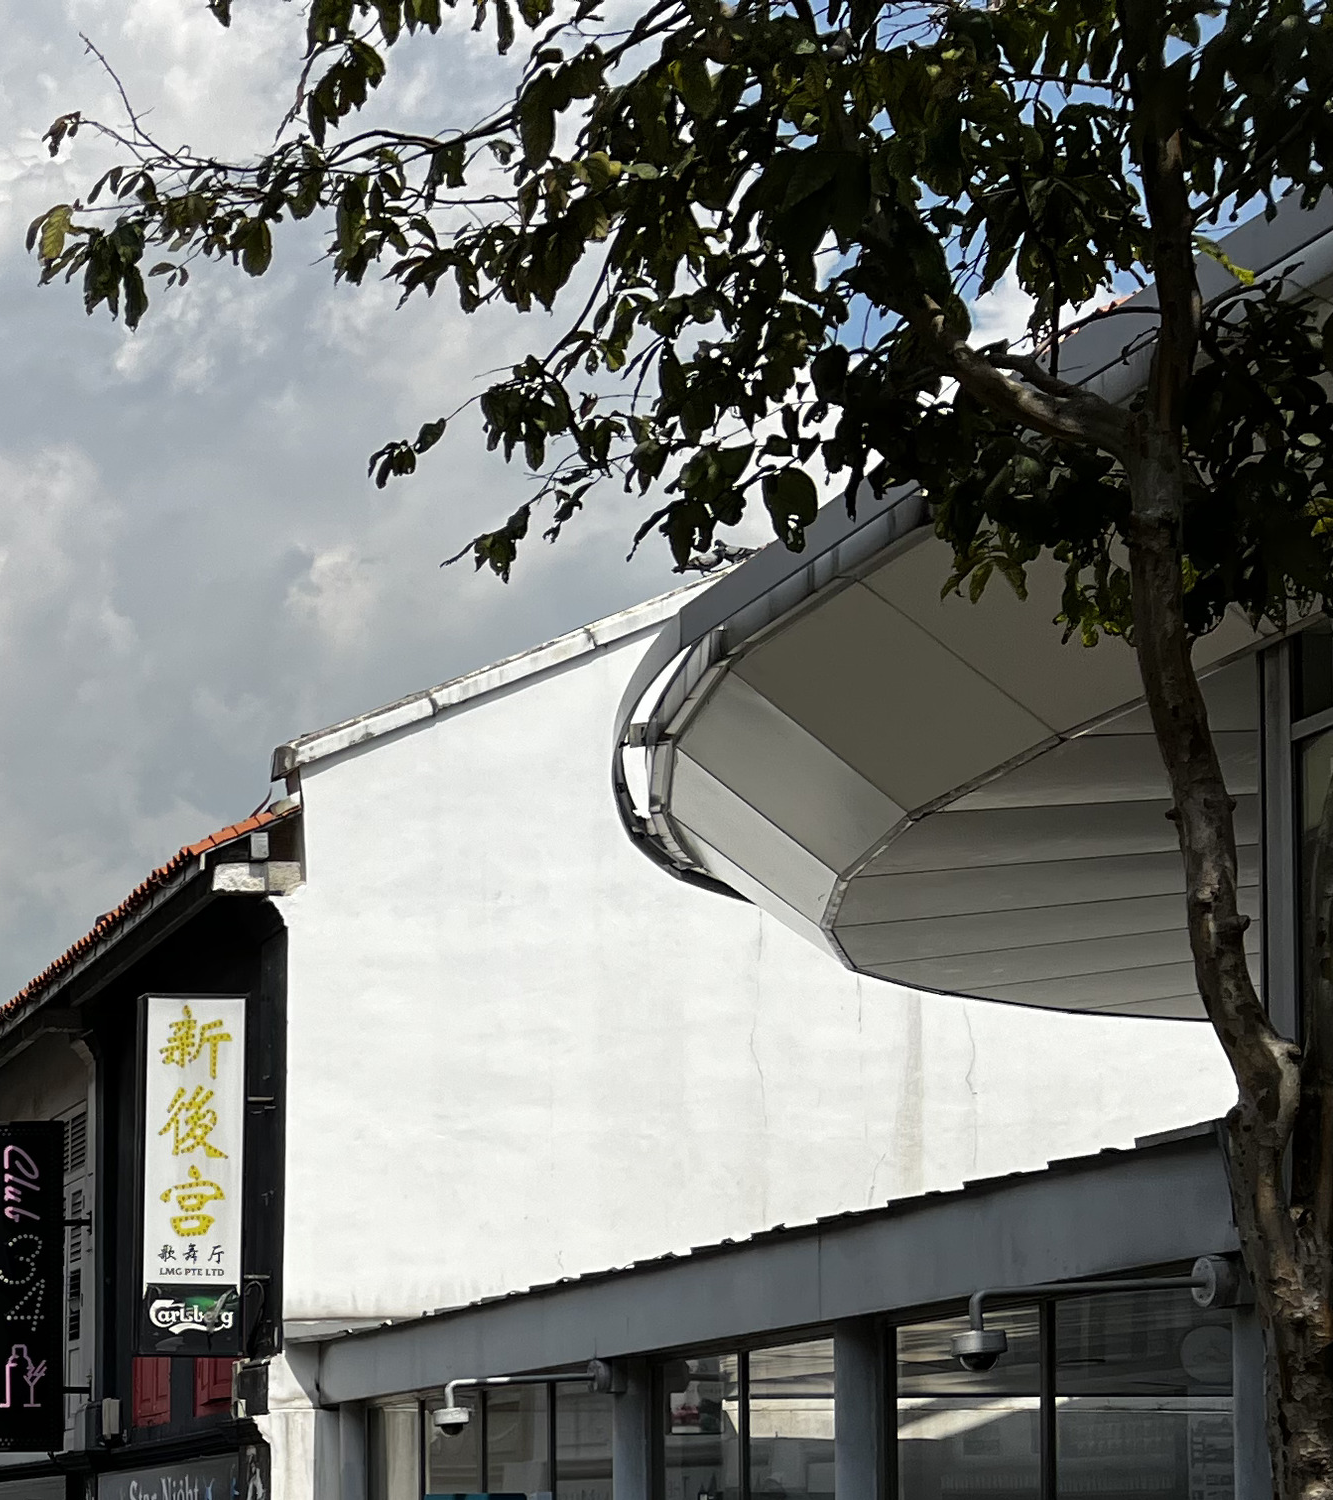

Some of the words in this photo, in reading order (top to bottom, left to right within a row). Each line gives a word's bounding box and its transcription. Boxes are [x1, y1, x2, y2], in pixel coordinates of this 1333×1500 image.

[3, 1145, 41, 1223] Club
[158, 1243, 225, 1264] 歌舞厅
[159, 1267, 183, 1276] LMG
[185, 1268, 203, 1276] PTE
[205, 1268, 225, 1277] LTD
[149, 1299, 234, 1330] Carlsbeg
